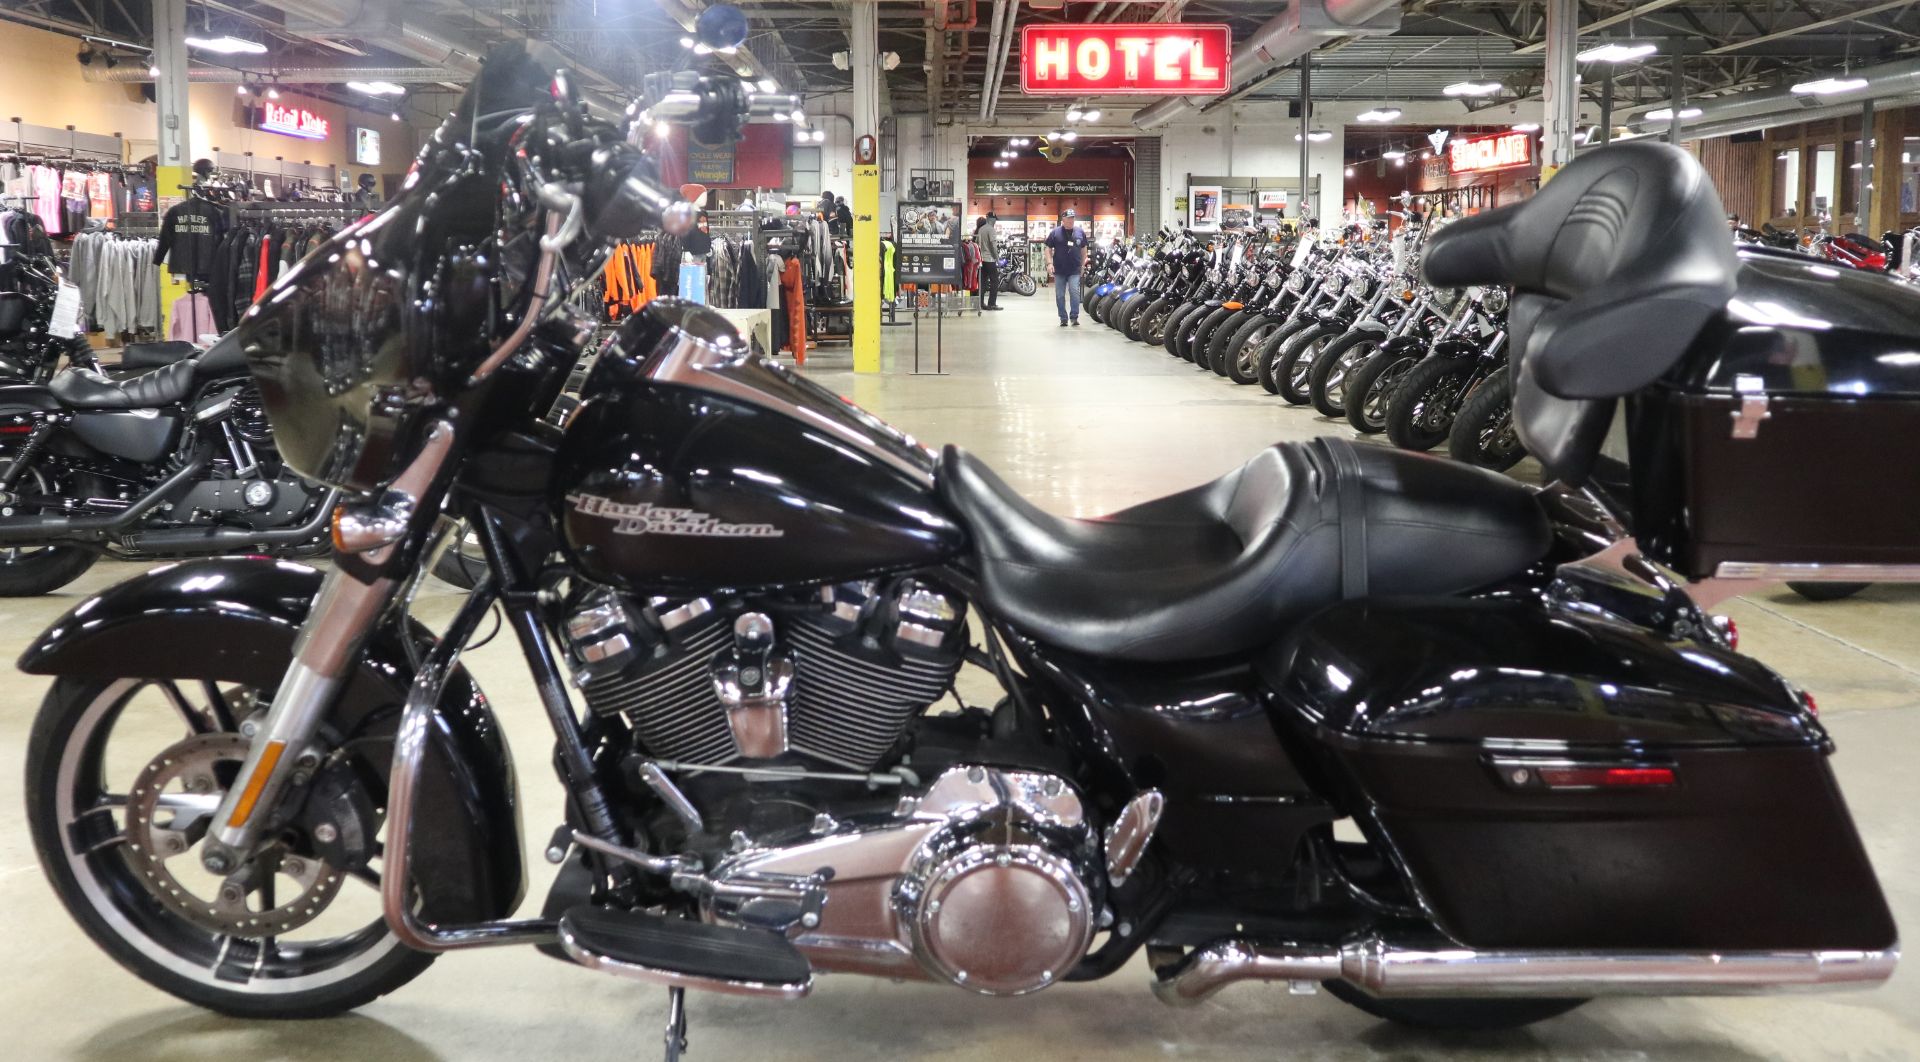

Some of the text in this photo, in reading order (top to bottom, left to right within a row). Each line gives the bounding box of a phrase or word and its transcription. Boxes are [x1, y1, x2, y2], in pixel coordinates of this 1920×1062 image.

[1035, 37, 1219, 81] HOTEL
[1452, 134, 1528, 171] SINCLAIR
[695, 169, 729, 182] Wrangler
[985, 183, 1003, 192] The
[1005, 183, 1029, 192] Road
[1031, 183, 1052, 192] Goes
[1067, 183, 1098, 192] Forever
[175, 225, 209, 233] DAVDSON
[613, 515, 784, 537] Davidson
